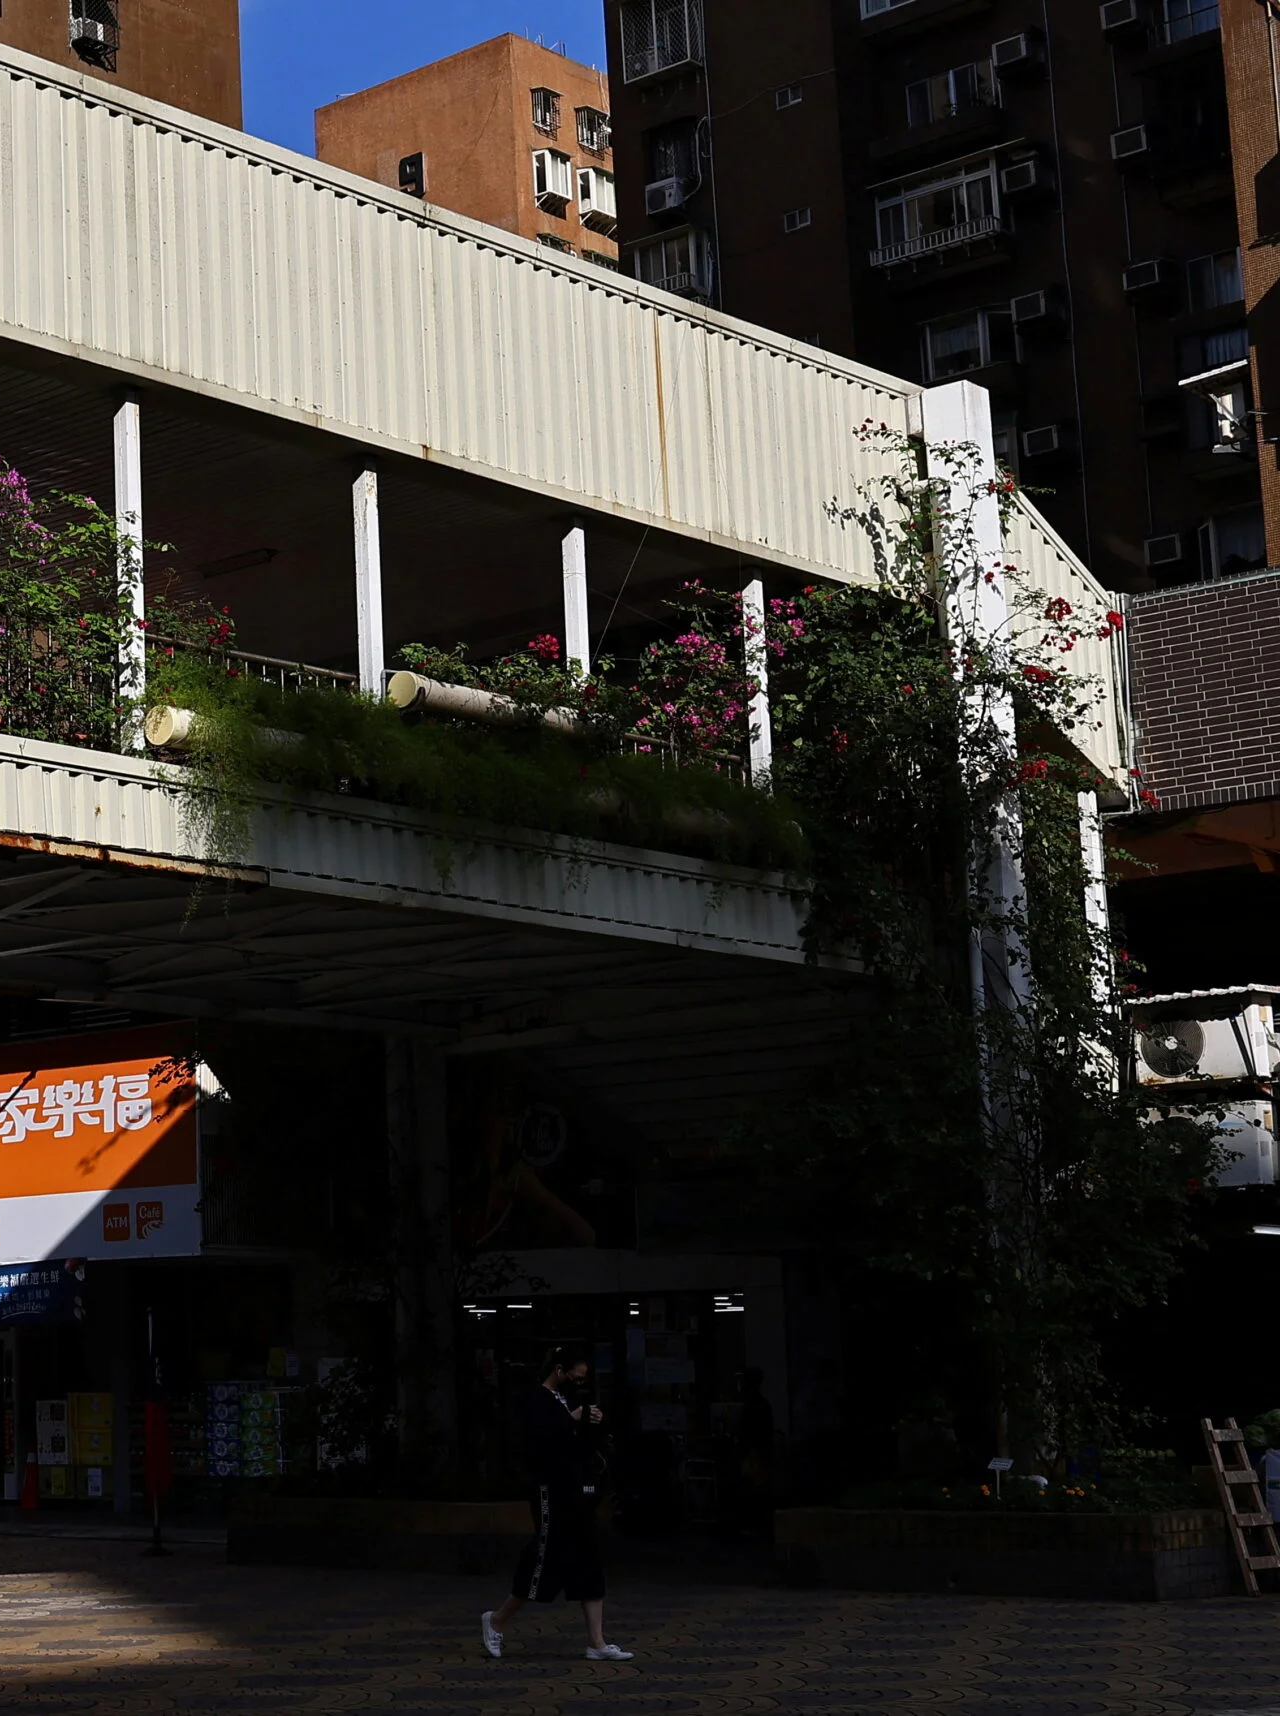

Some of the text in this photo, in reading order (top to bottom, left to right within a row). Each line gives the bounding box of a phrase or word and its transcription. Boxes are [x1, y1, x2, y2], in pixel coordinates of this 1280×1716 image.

[399, 151, 425, 198] 9
[139, 1205, 162, 1220] Café
[105, 1216, 128, 1229] ATM
